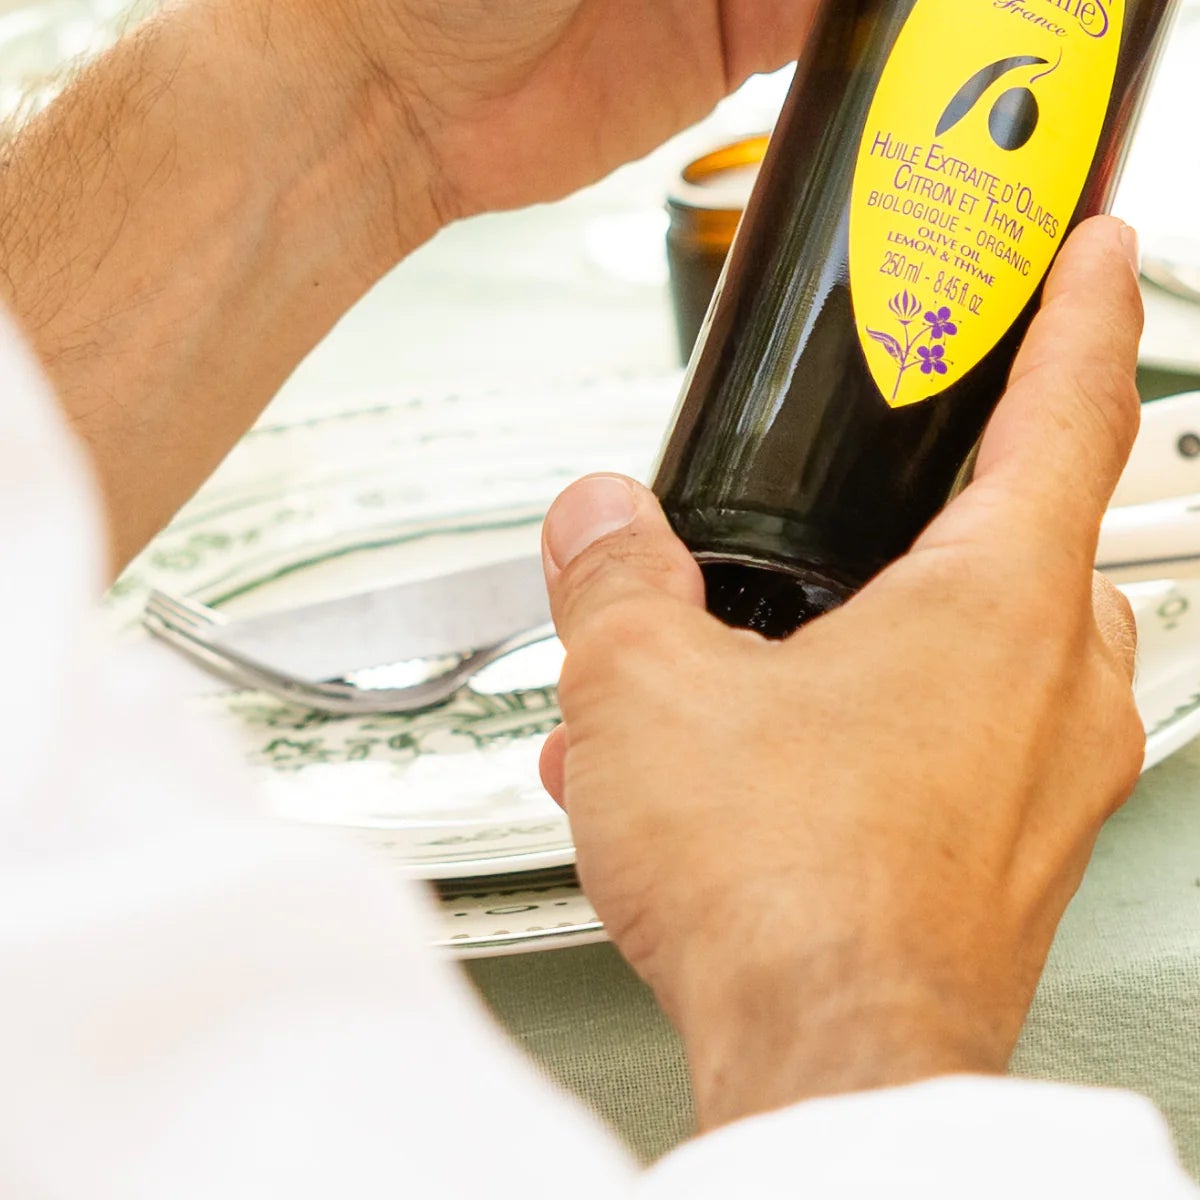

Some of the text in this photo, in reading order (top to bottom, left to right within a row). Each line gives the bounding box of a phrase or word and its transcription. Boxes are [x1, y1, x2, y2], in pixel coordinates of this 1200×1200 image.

[958, 193, 980, 216] ET
[867, 190, 960, 233] BIOLOGIQUE
[976, 230, 1032, 277] ORGANIC
[917, 226, 981, 264] OLIVE OIL
[879, 250, 907, 278] 250
[903, 261, 924, 284] ml
[887, 231, 996, 288] LEMON & THYME
